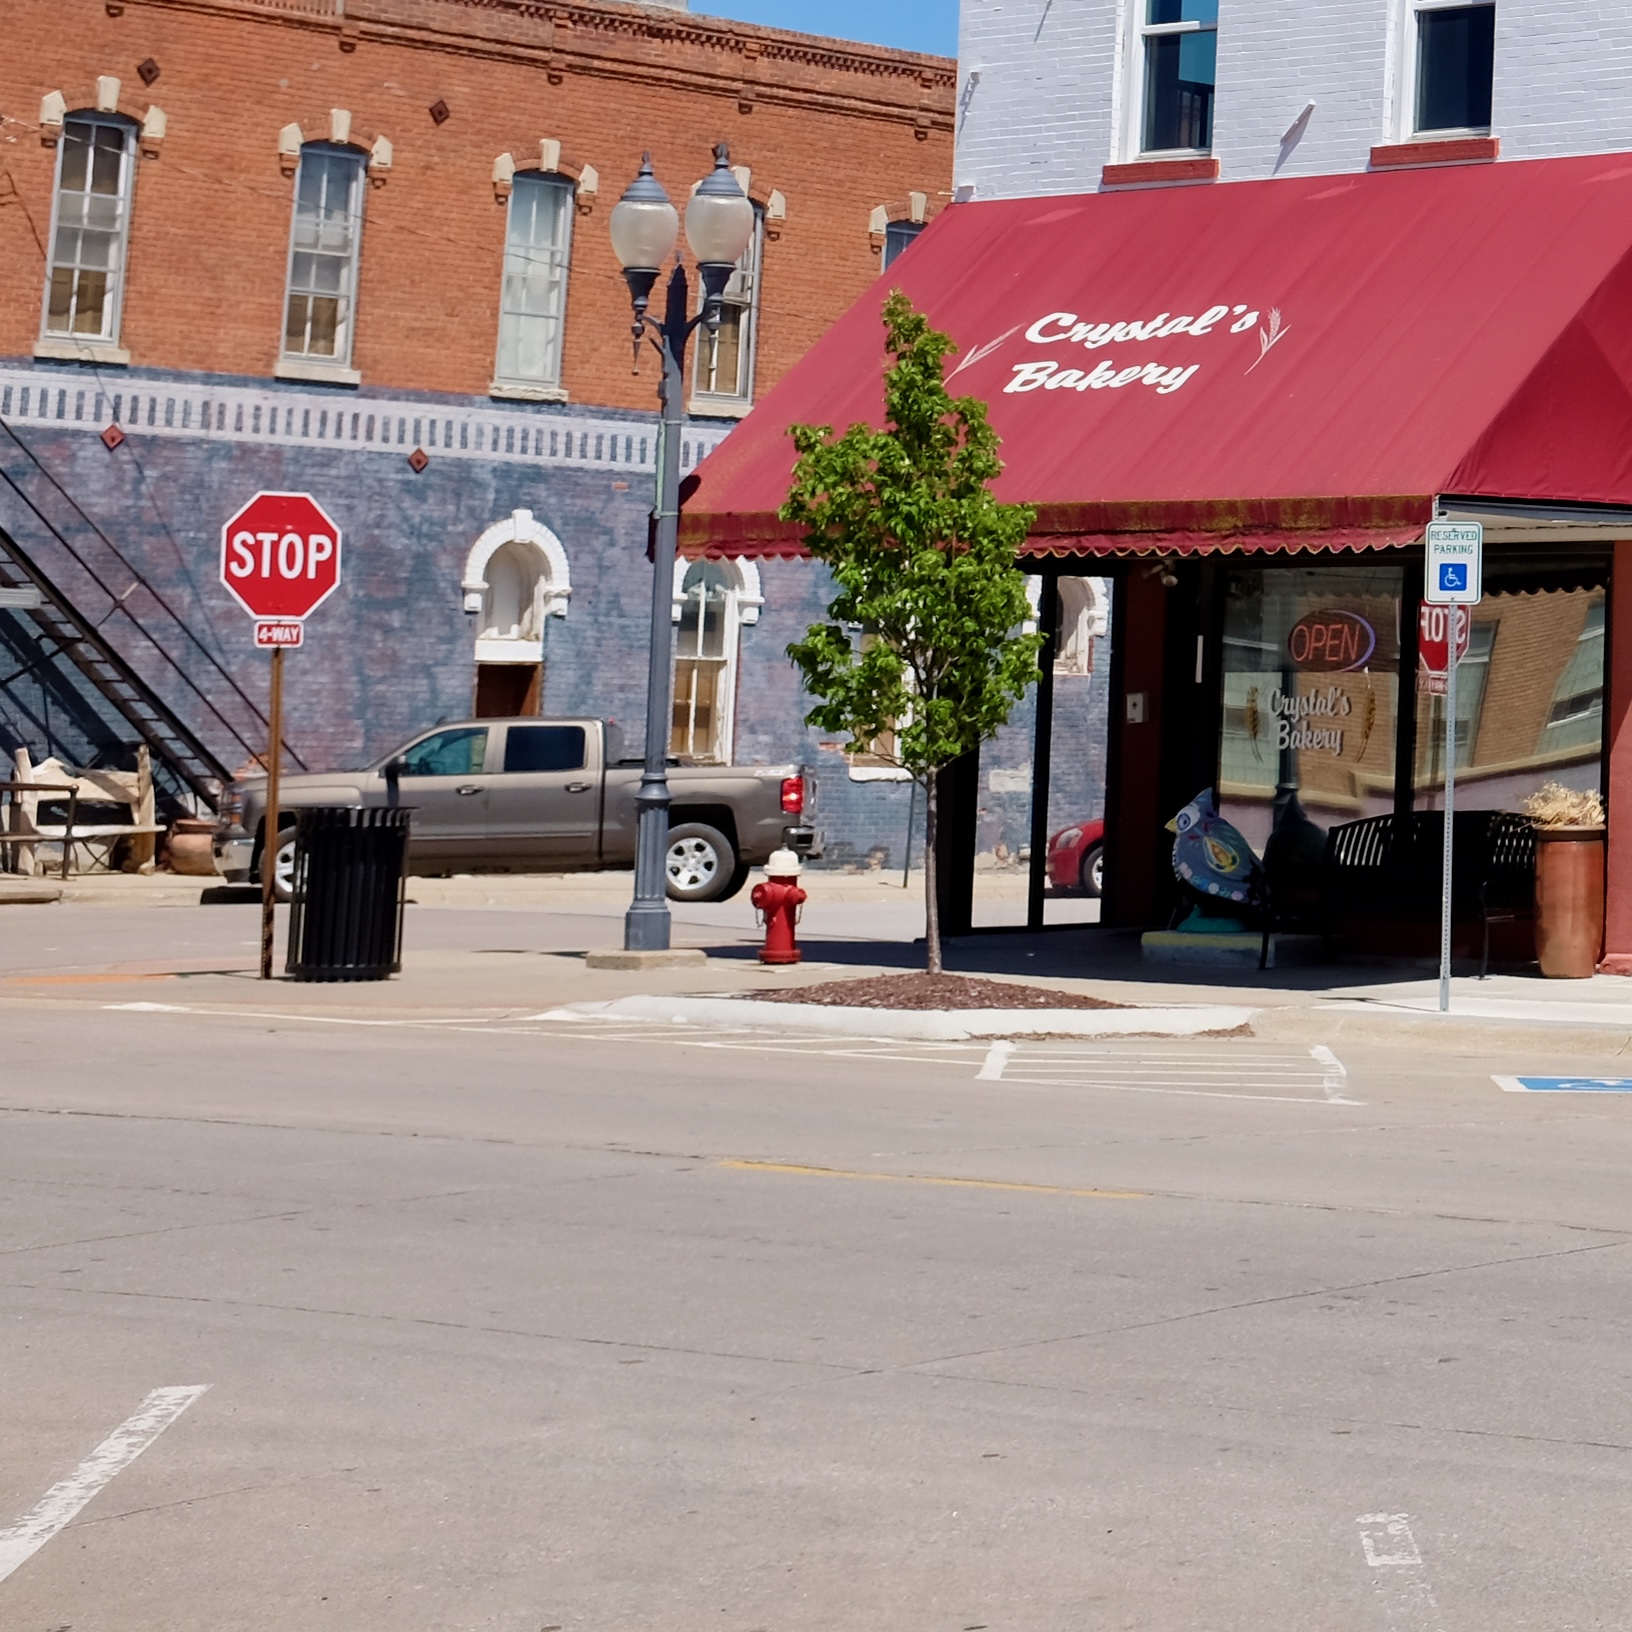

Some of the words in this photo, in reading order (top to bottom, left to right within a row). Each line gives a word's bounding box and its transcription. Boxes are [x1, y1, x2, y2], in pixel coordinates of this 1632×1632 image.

[1024, 304, 1260, 349] Crystal's
[1002, 360, 1201, 394] Bakery
[1430, 530, 1478, 541] RESERVED
[1433, 544, 1474, 555] PARKING
[229, 530, 333, 580] STOP
[258, 626, 300, 642] 4-WAY
[1290, 623, 1361, 661] OPEN
[1269, 687, 1353, 722] Crystal's
[1275, 719, 1344, 756] Bakery
